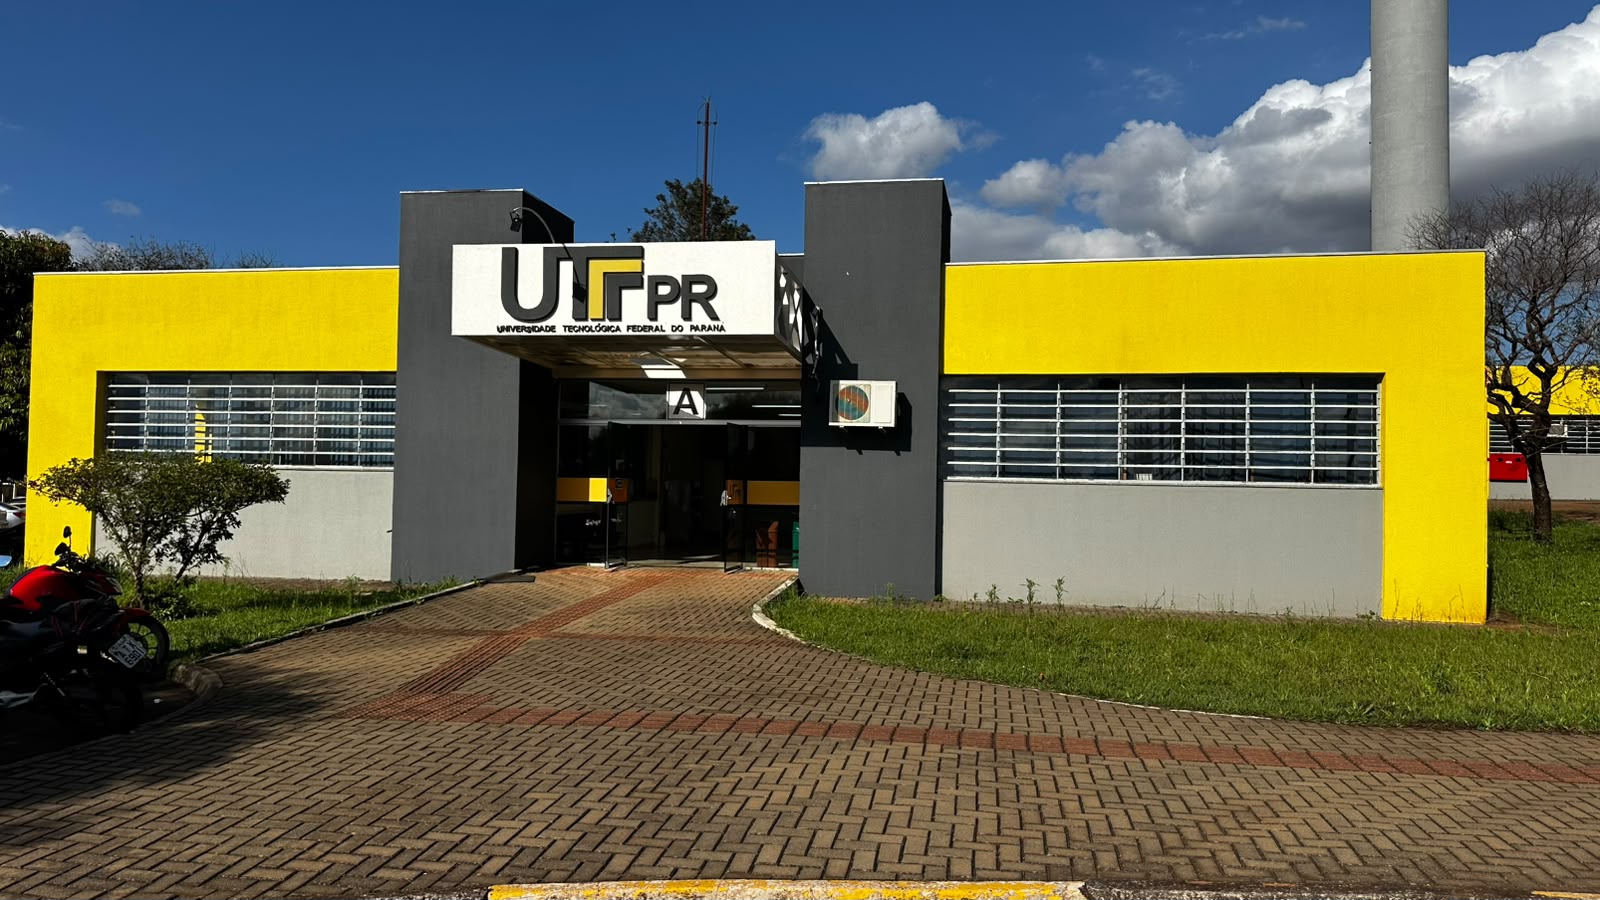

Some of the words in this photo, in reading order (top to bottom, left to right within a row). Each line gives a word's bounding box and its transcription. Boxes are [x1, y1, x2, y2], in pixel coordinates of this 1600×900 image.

[501, 246, 721, 323] UTFPR
[497, 325, 556, 334] UNIVERSIDADE
[563, 323, 622, 333] TECNOLÓGICA
[626, 324, 666, 333] FEDERAL
[671, 324, 684, 333] DO
[673, 388, 699, 415] A
